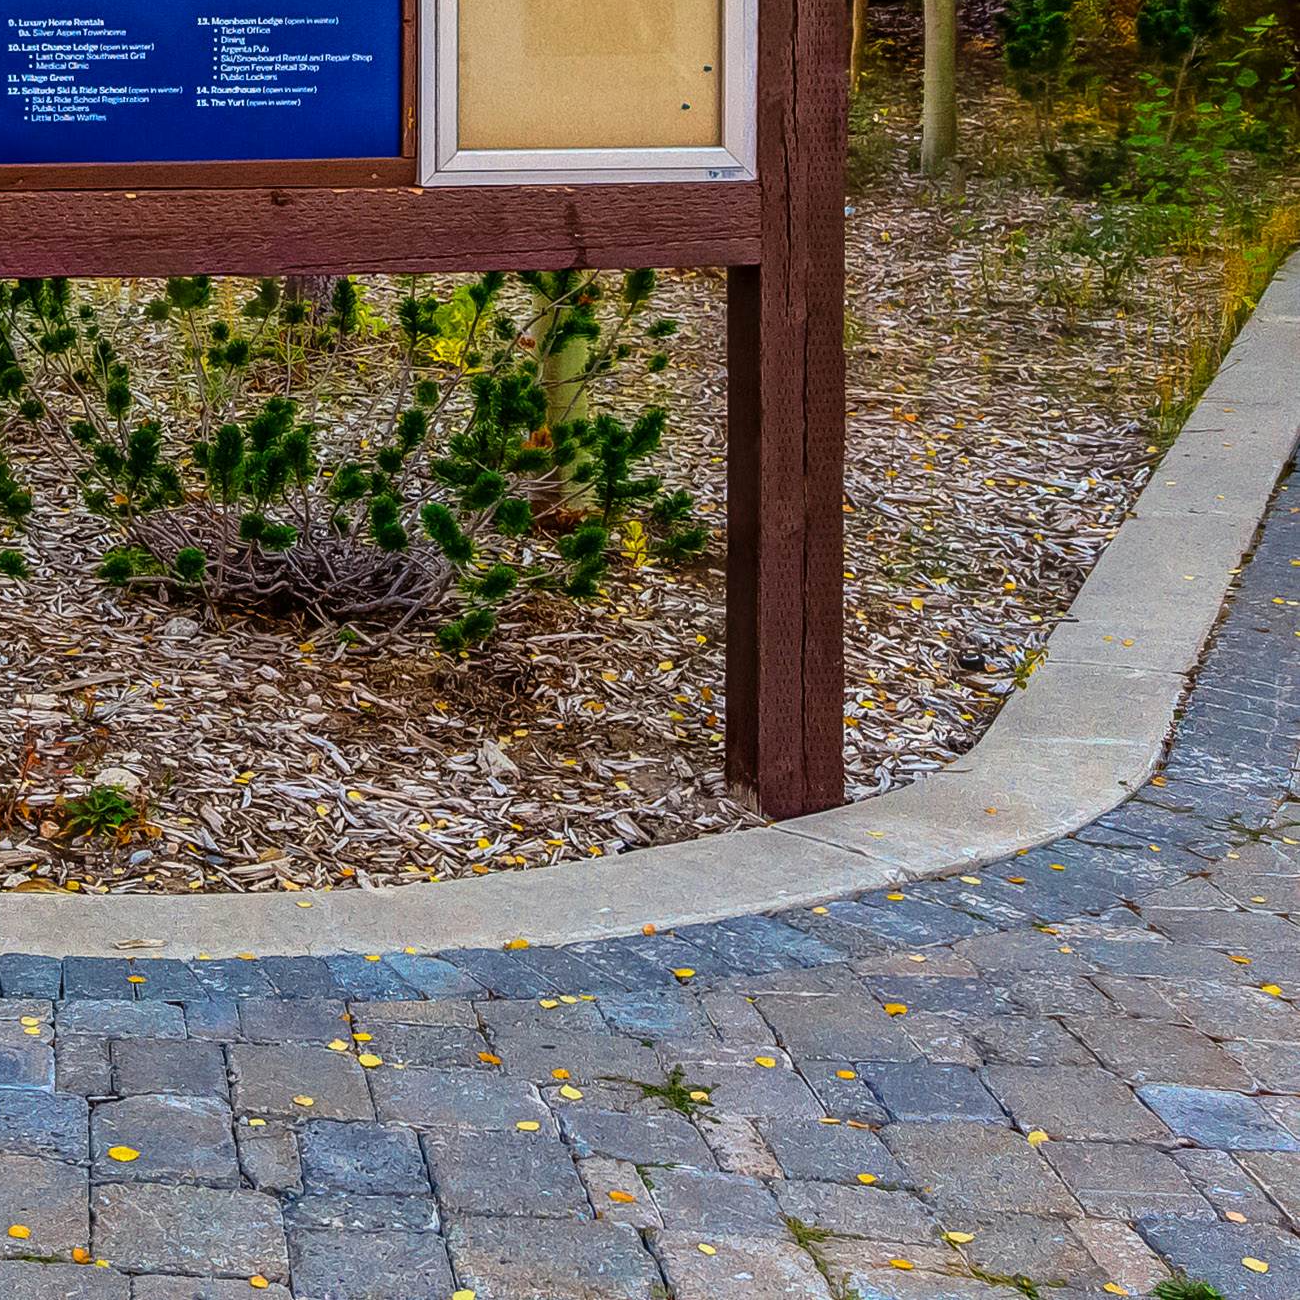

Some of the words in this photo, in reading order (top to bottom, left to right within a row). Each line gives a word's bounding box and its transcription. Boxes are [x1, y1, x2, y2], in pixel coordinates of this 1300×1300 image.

[19, 19, 47, 28] Luxury
[258, 17, 283, 26] Lodge
[314, 17, 339, 25] winter)
[8, 44, 21, 52] 10.
[74, 44, 98, 52] Lodge
[221, 46, 252, 54] Argenta
[221, 55, 281, 63] Ski/Snowboard
[325, 54, 350, 62] Repair
[352, 54, 372, 62] Shop
[221, 64, 250, 73] Canyon
[299, 64, 319, 72] Shop
[22, 75, 47, 83] Village
